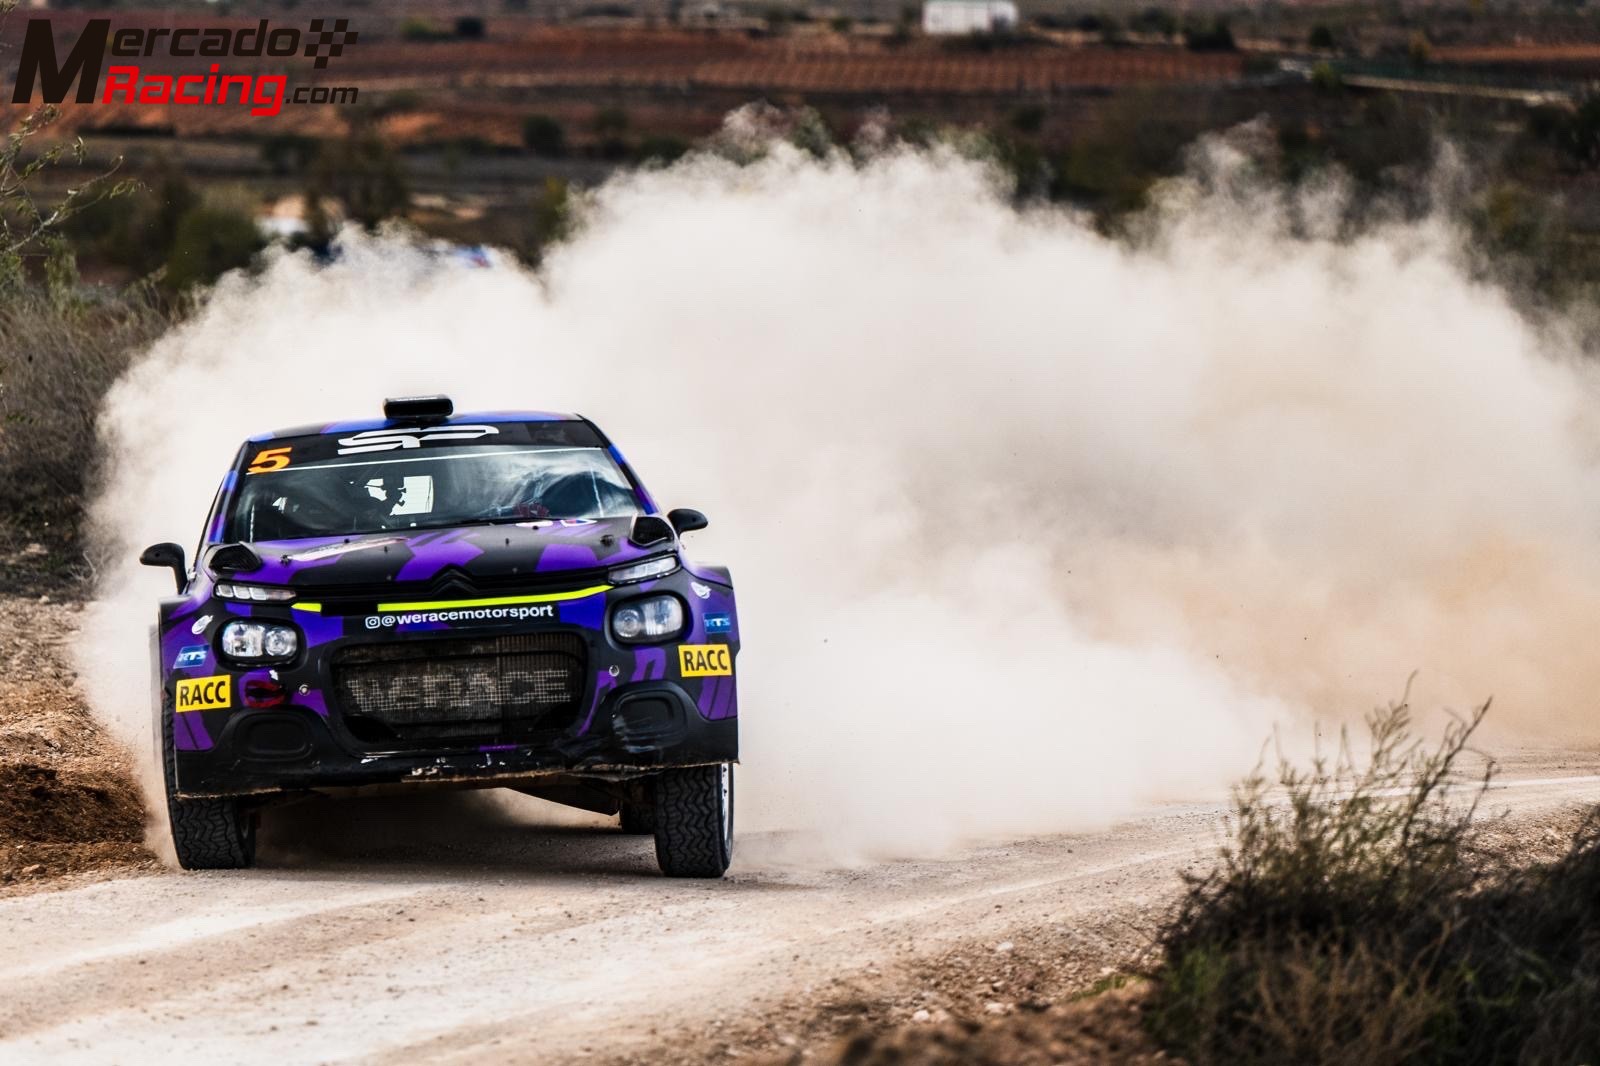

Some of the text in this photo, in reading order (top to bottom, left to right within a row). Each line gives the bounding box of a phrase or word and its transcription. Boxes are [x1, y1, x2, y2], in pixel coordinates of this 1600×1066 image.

[249, 447, 292, 474] 5
[381, 604, 554, 627] @weracemotorsport
[683, 649, 728, 672] RACC
[179, 680, 227, 707] RACC
